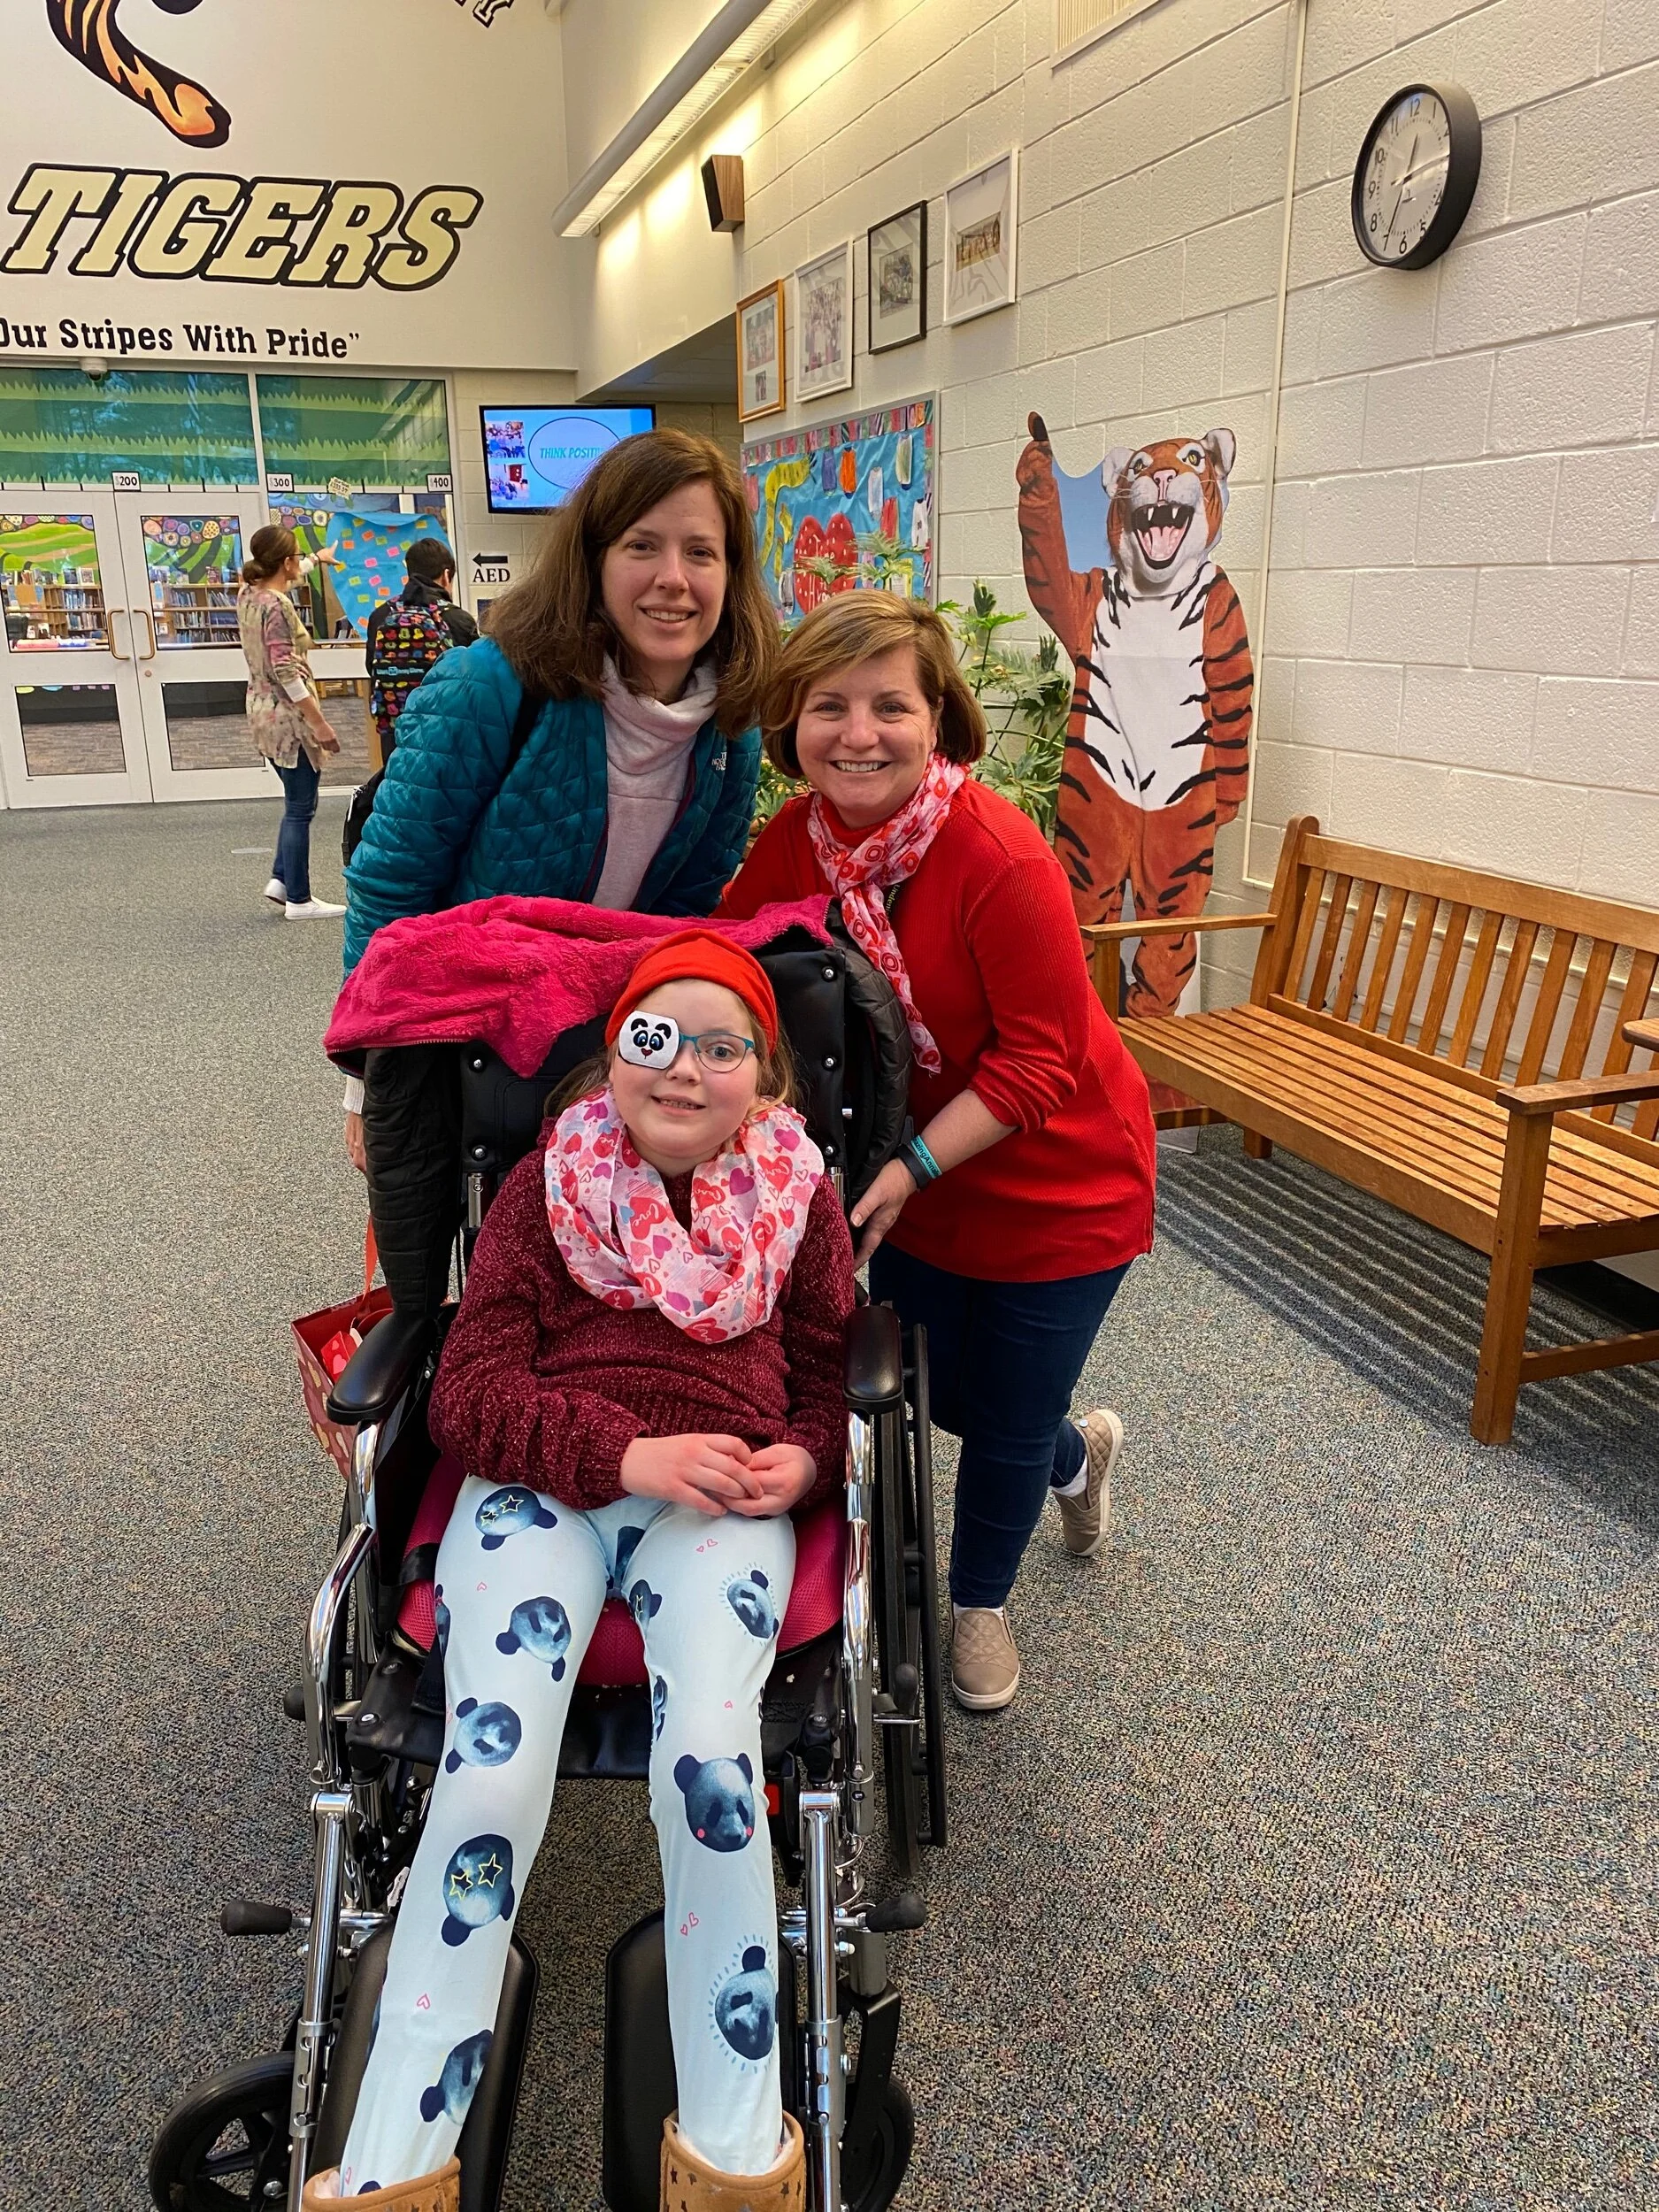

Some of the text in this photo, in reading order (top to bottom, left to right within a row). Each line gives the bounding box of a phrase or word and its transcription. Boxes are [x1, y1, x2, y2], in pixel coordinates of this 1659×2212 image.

[1409, 98, 1421, 117] 12
[1375, 148, 1385, 166] 10
[1368, 180, 1377, 200] 9
[1, 162, 484, 291] TIGERS
[1371, 213, 1378, 233] 8
[1399, 235, 1407, 254] 6
[58, 319, 173, 354] Stripes
[183, 324, 257, 354] With
[540, 447, 566, 459] THINK
[472, 568, 511, 583] AED
